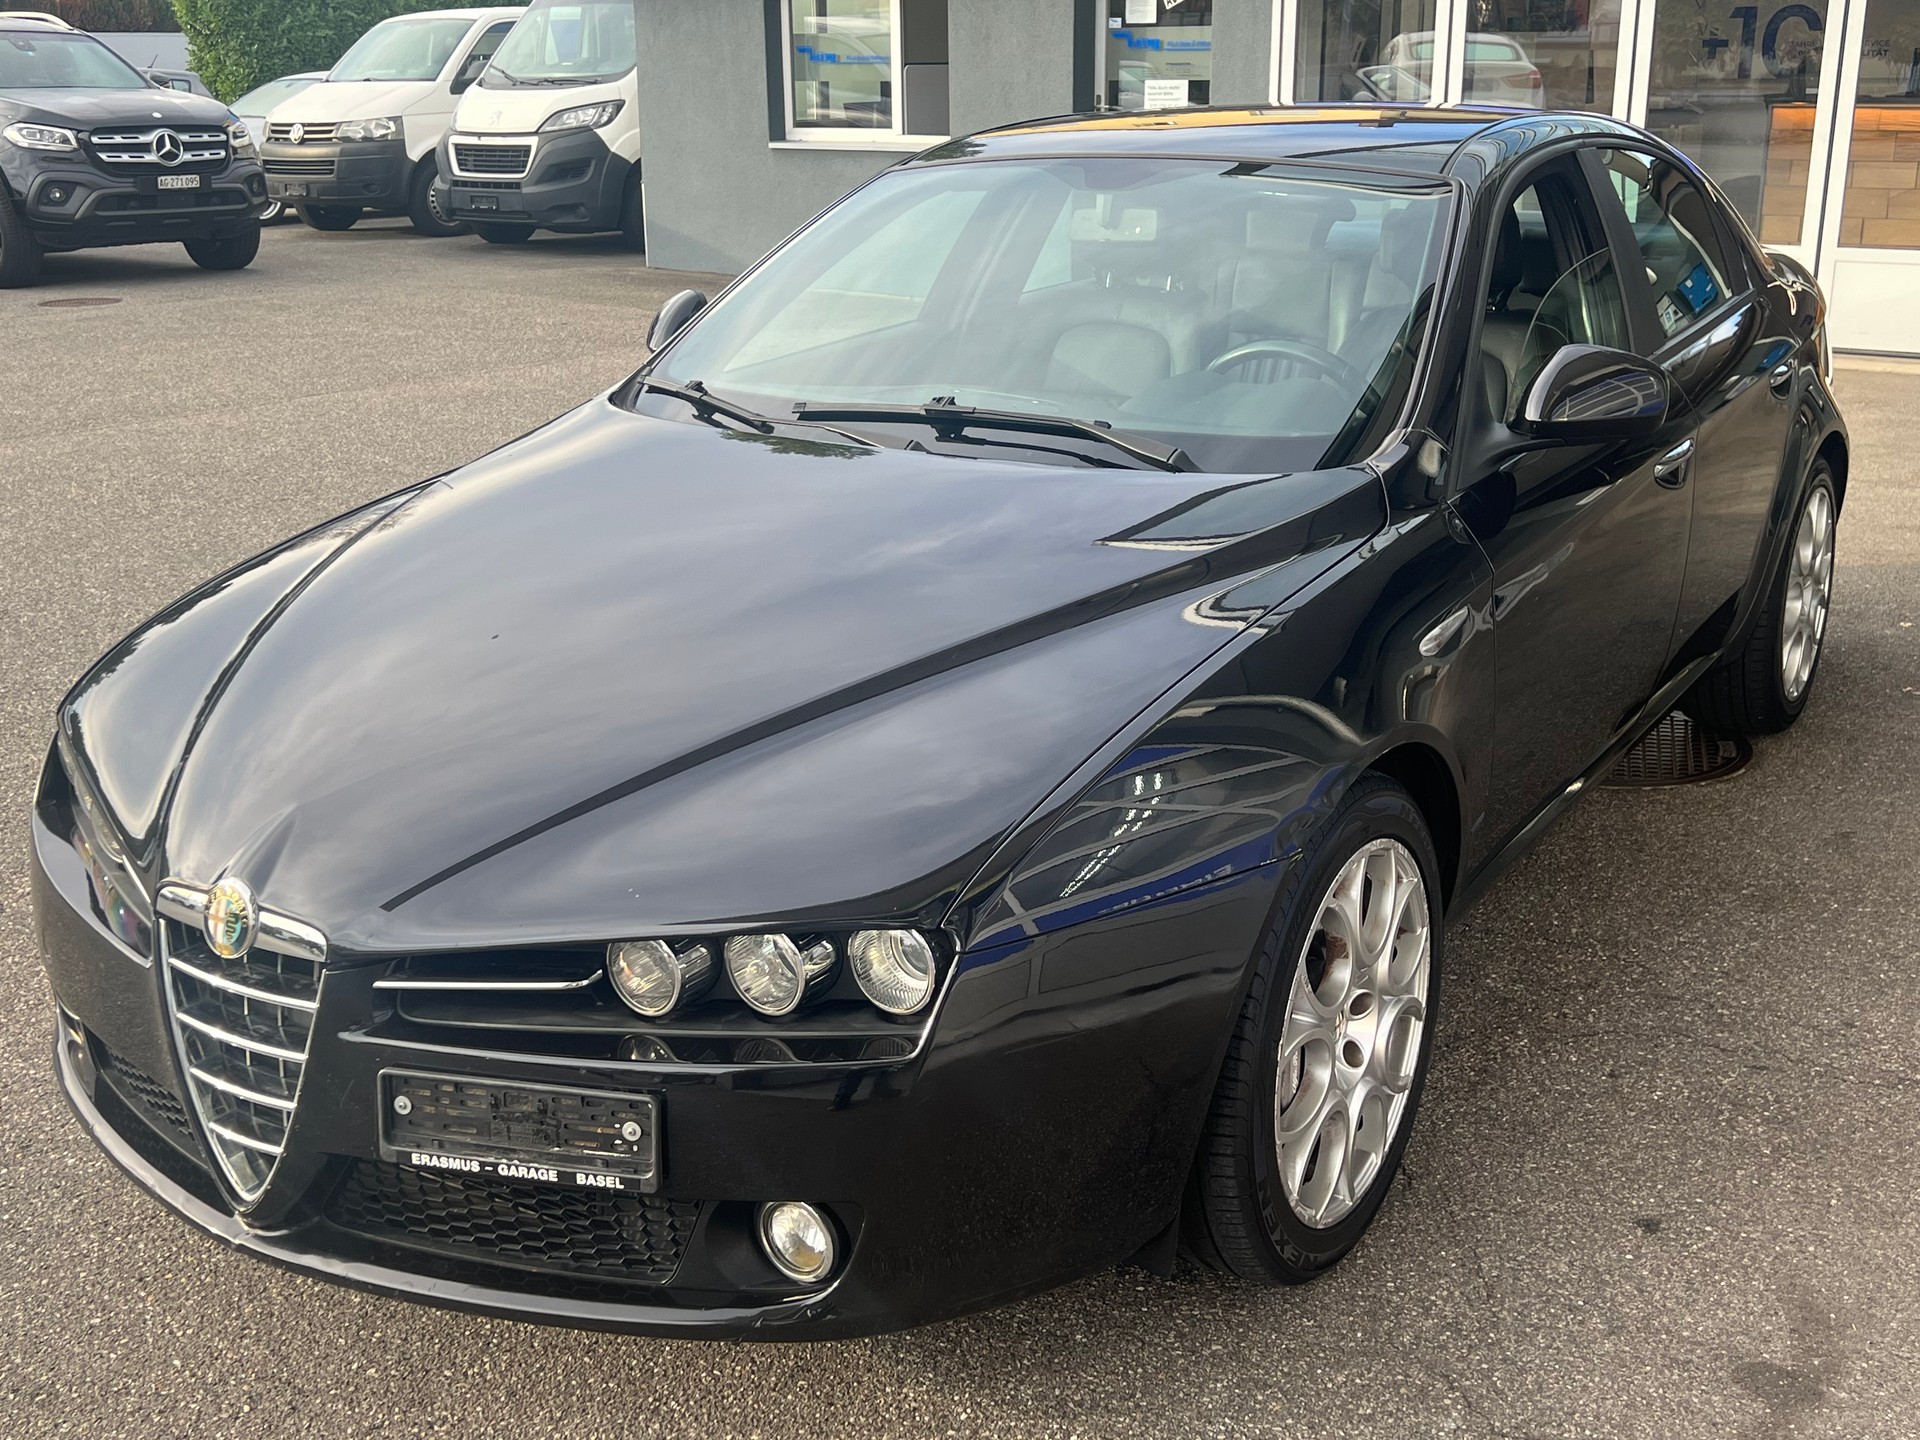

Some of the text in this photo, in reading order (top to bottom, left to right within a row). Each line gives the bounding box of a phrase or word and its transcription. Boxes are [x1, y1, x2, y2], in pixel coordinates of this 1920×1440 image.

[410, 1152, 480, 1173] ERASMUS
[497, 1163, 558, 1182] GARAGE
[575, 1173, 625, 1190] BASEL
